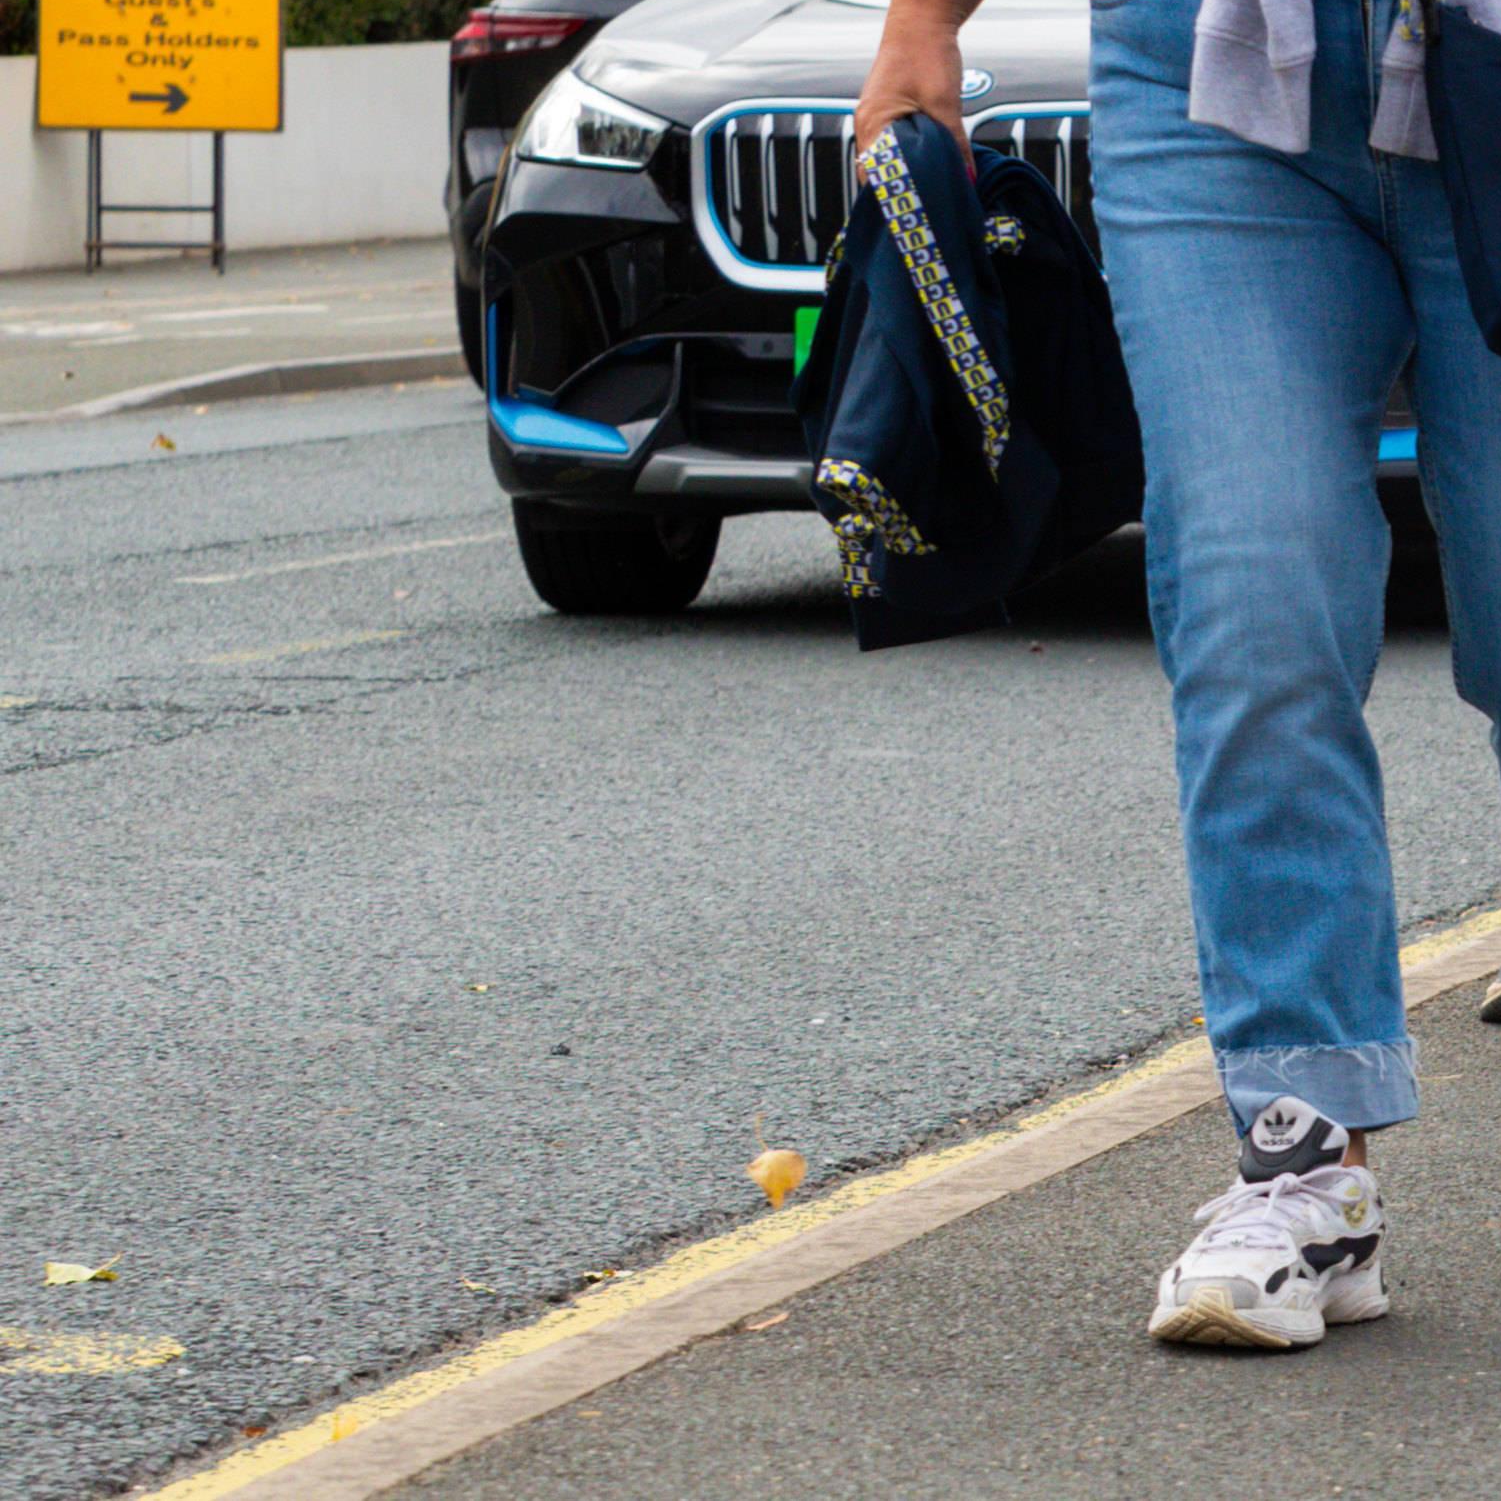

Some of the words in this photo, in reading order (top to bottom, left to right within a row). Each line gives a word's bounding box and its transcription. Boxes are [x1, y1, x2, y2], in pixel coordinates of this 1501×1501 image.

[149, 12, 169, 27] &
[57, 30, 130, 47] Pass
[144, 31, 260, 48] Holders
[125, 51, 195, 70] Only
